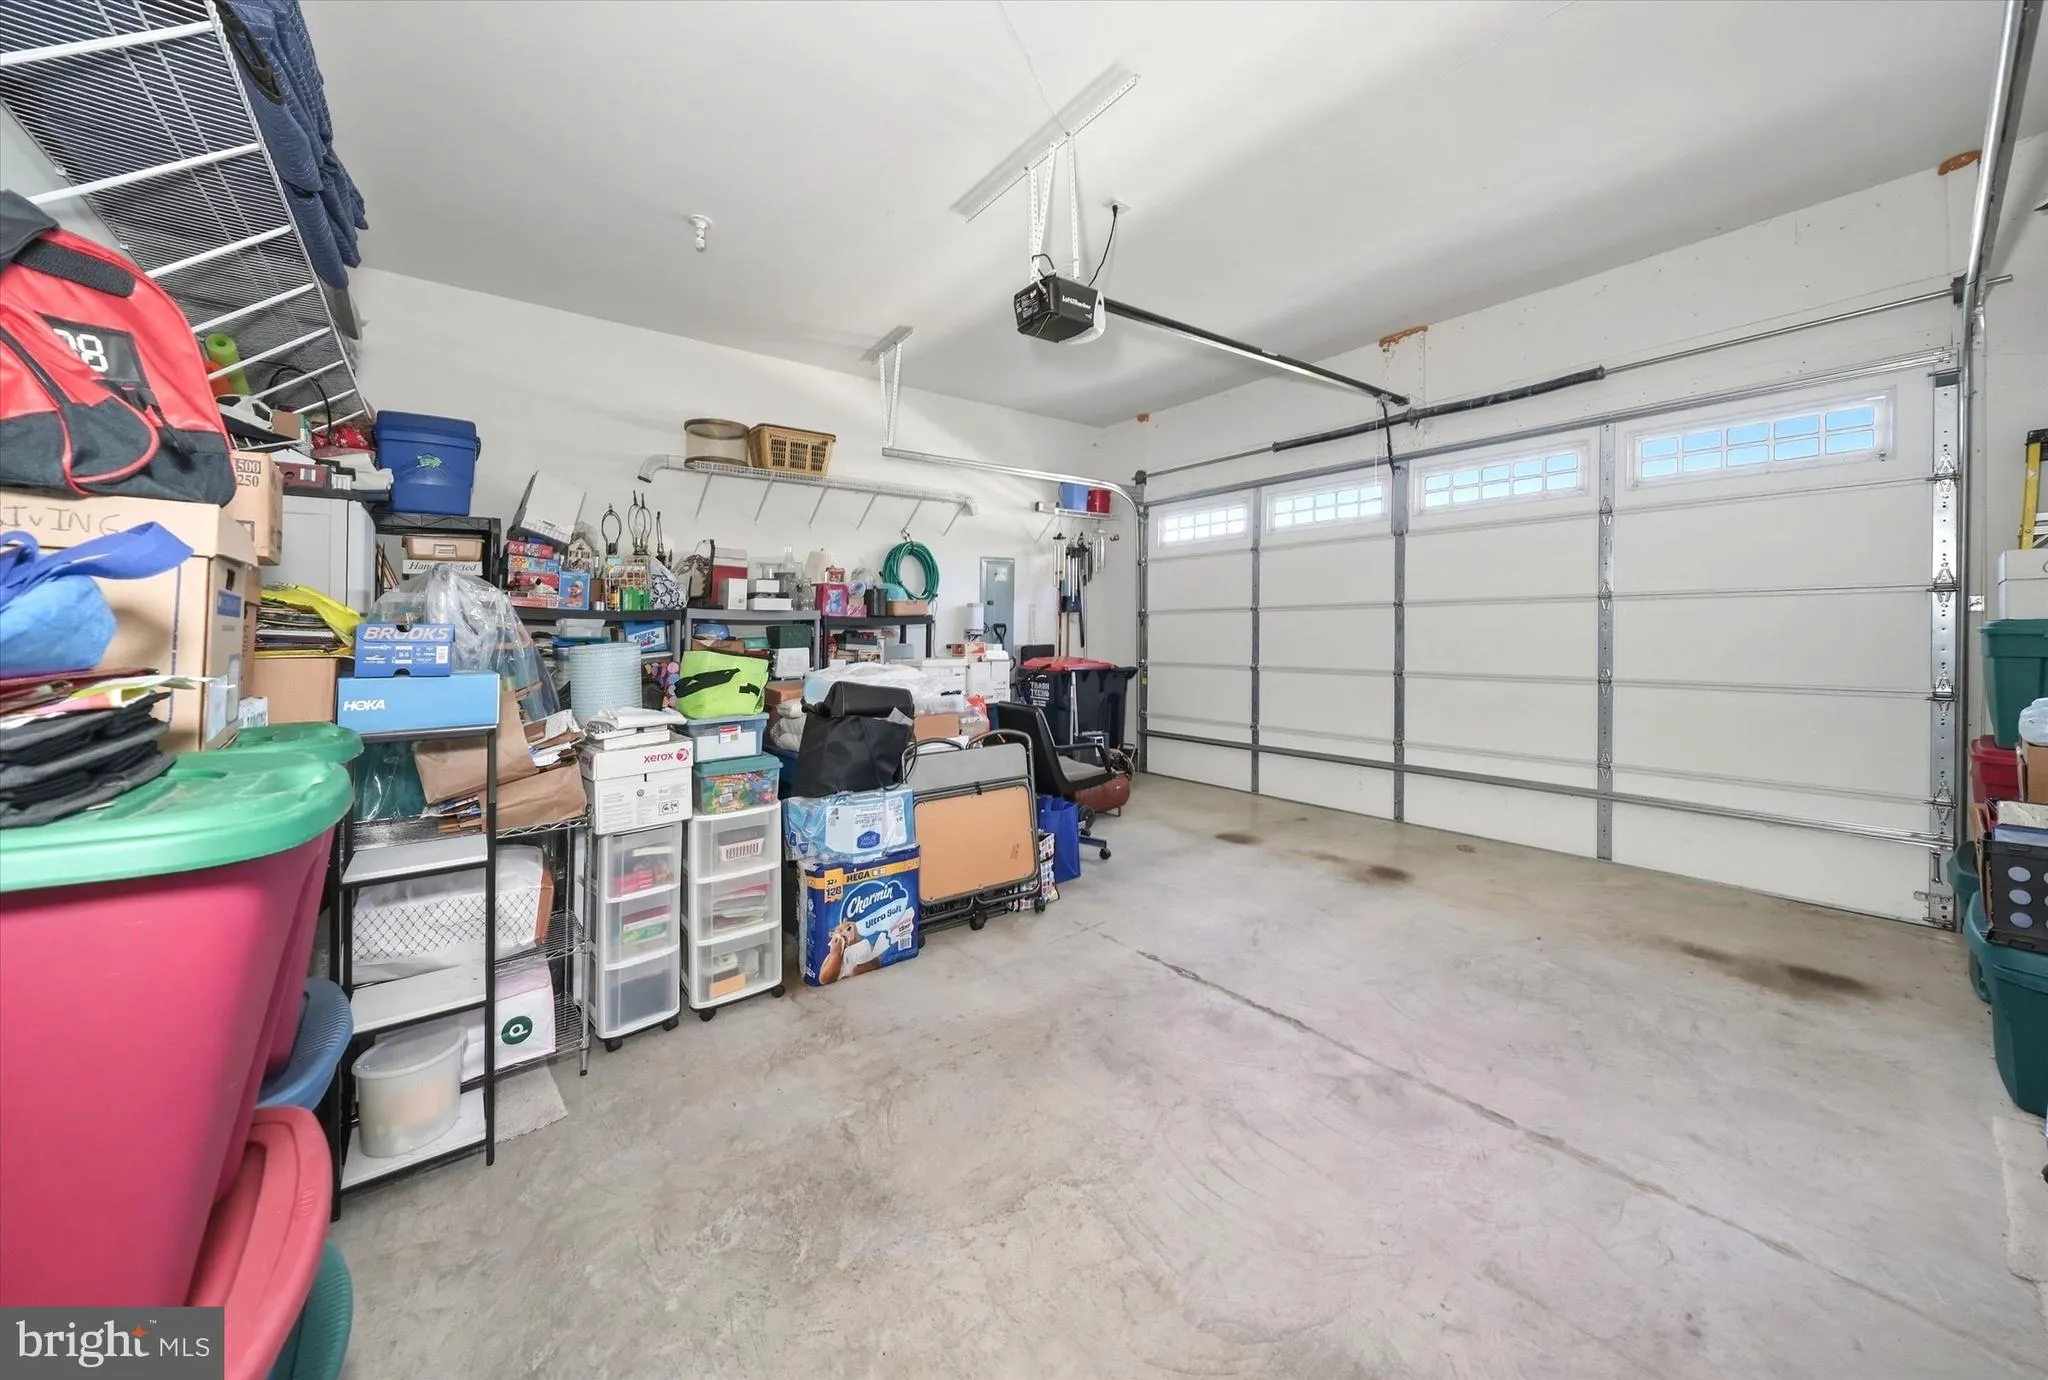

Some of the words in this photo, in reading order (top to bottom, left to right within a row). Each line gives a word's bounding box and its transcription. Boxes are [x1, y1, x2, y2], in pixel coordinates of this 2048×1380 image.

[237, 474, 260, 487] 250
[363, 626, 451, 641] BROOKS
[343, 699, 386, 712] HOKA
[643, 752, 674, 764] xerox
[846, 885, 894, 918] Charmin
[865, 913, 886, 928] Ultra
[887, 905, 902, 917] Soft
